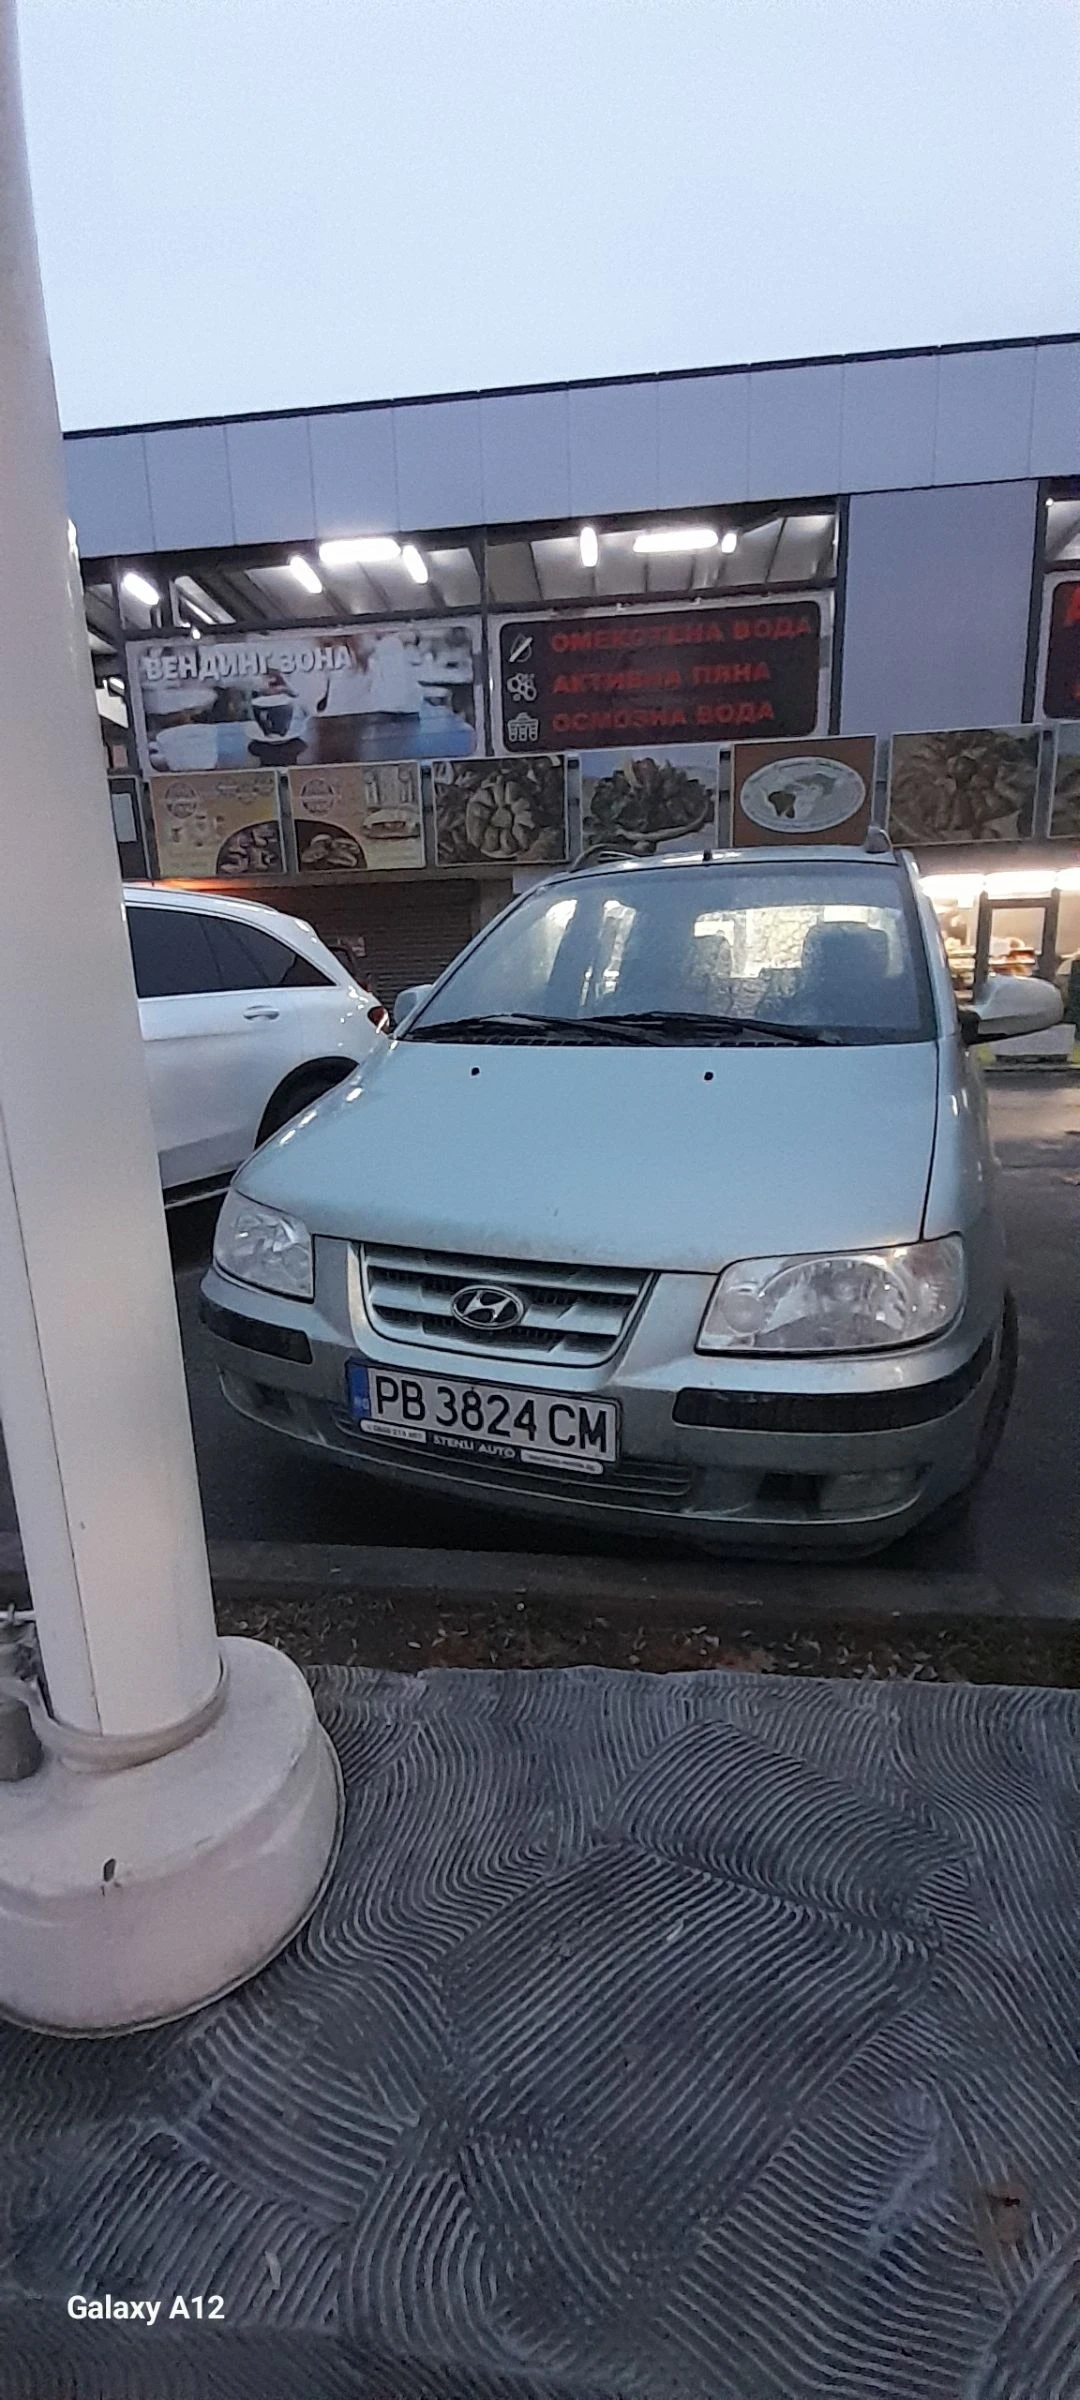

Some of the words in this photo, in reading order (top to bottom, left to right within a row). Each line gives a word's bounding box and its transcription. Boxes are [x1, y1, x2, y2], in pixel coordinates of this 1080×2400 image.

[551, 622, 722, 652] ОМЕКОТЕНА
[732, 616, 812, 641] ВОДА
[145, 649, 269, 681] ВЕНДИНГ
[278, 645, 354, 674] ЗОНА
[553, 670, 681, 695] АКТИВНА
[692, 662, 771, 684] ПЯНА
[552, 709, 686, 732] ОСМОЗНА
[694, 702, 774, 726] ВОДА
[375, 1375, 426, 1421] PB
[436, 1386, 537, 1441] 3824
[549, 1404, 607, 1453] CM
[478, 1443, 516, 1460] AUTO
